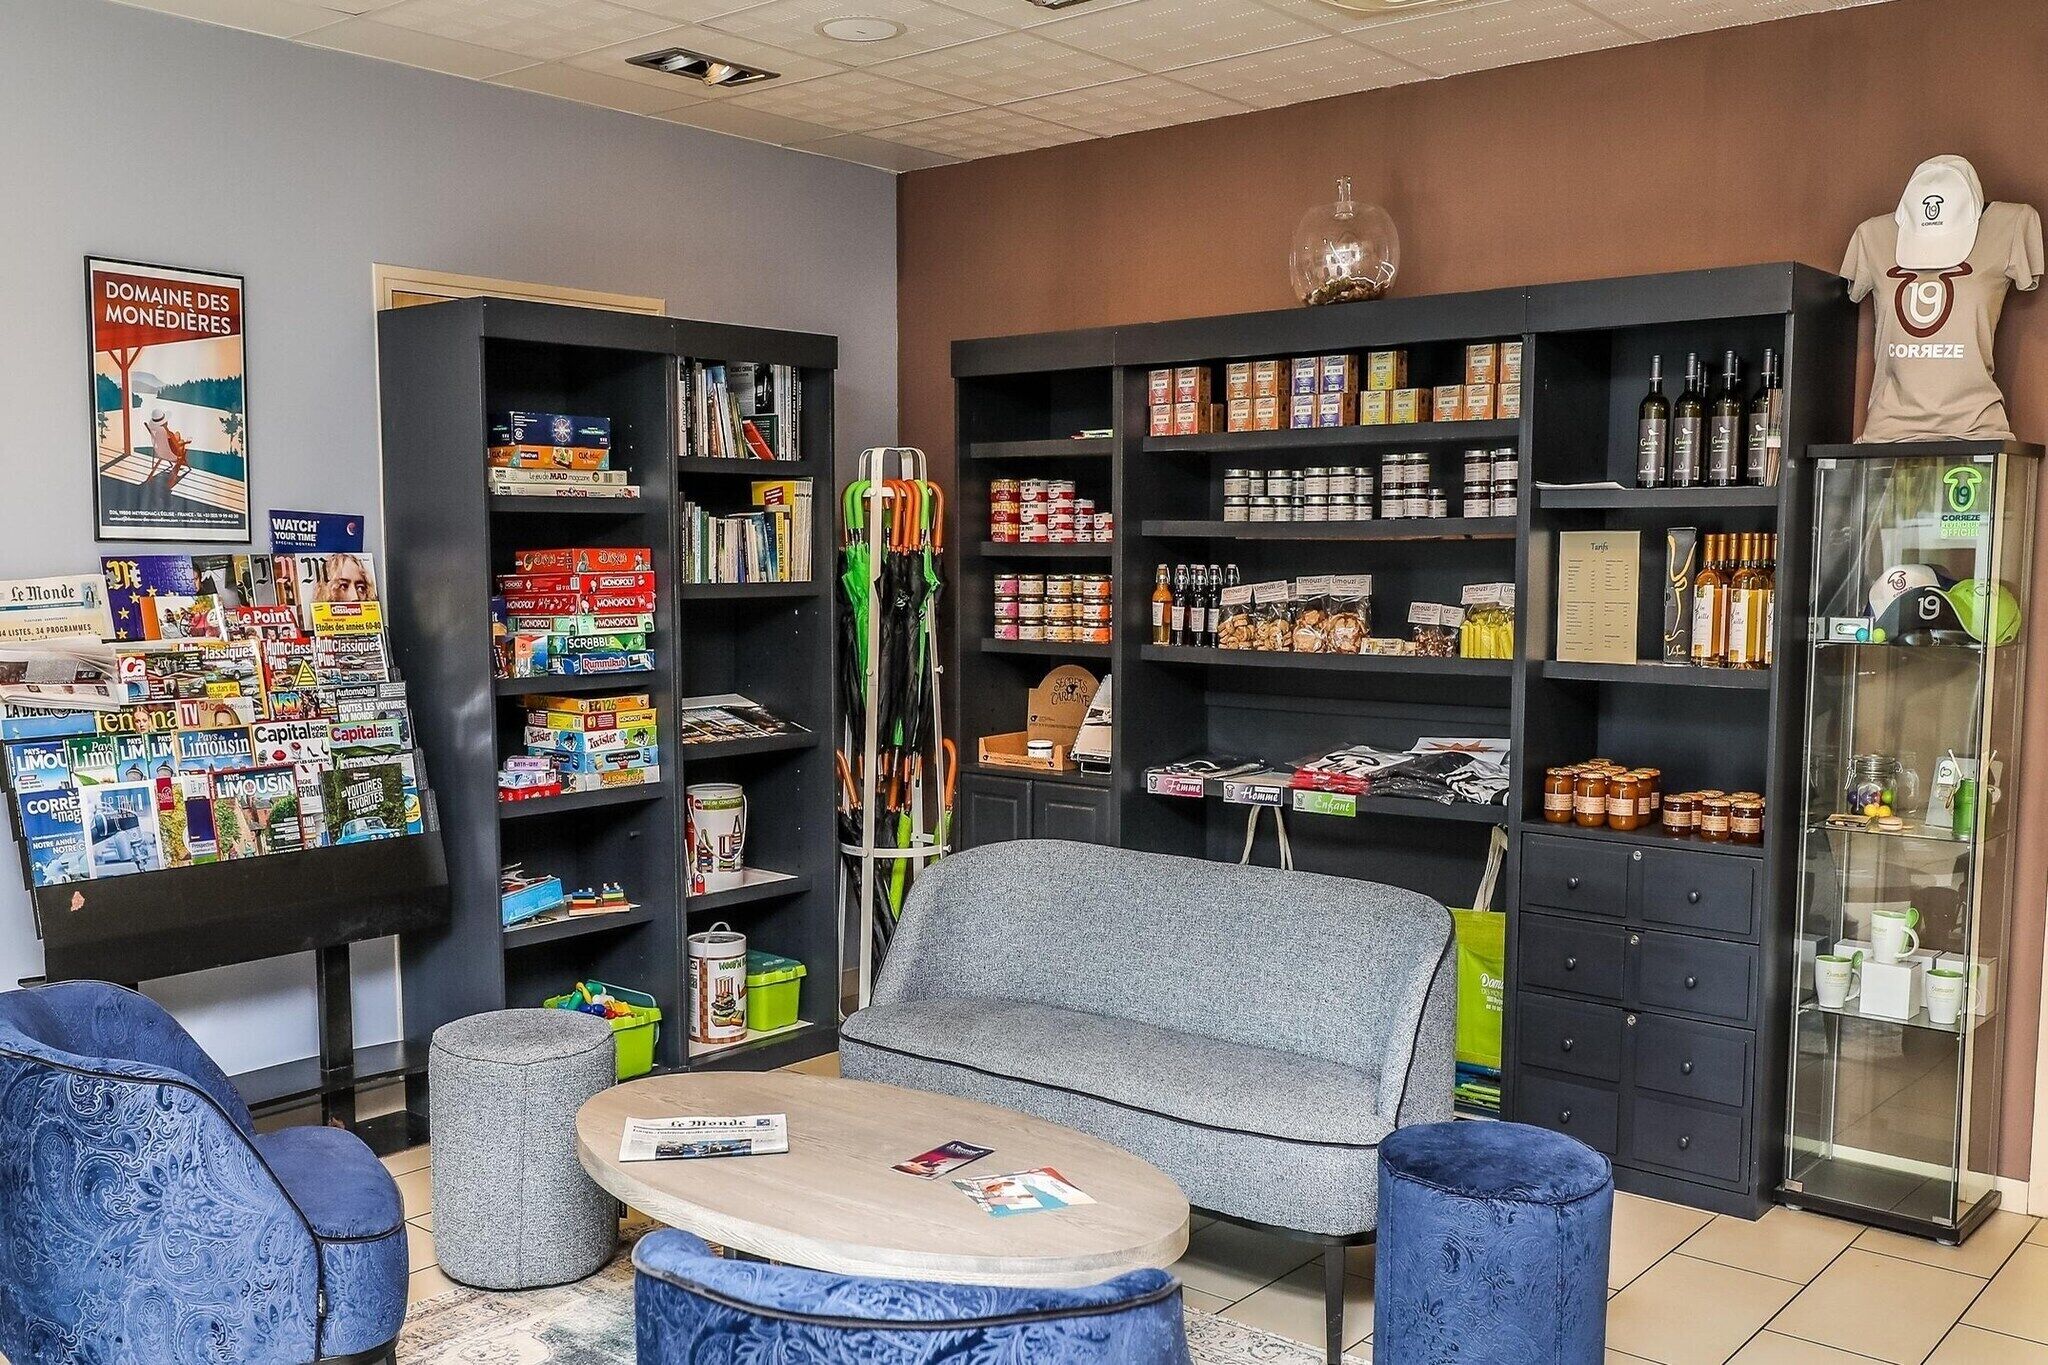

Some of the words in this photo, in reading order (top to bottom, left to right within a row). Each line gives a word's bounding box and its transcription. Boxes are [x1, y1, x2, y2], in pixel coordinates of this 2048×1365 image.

[1928, 204, 1938, 217] 19
[106, 281, 192, 309] DOMAINE
[197, 292, 230, 312] DES
[1908, 281, 1944, 324] 19
[105, 305, 231, 335] MONÉDIÈRES
[272, 518, 318, 534] WATCH
[274, 532, 296, 541] YOUR
[297, 533, 317, 542] TIME
[1590, 542, 1608, 553] Tarifs
[602, 578, 634, 587] MONOPOLY
[1331, 578, 1356, 586] Limouzi
[11, 585, 24, 602] Le
[26, 584, 75, 601] Monde
[506, 600, 536, 608] MONOPOLY
[596, 596, 636, 608] MONOPOLY
[1918, 594, 1940, 620] 19
[237, 611, 252, 624] Le
[254, 610, 292, 624] Point
[520, 619, 550, 628] MONOPOLY
[597, 618, 638, 627] MONOPOLY
[8, 628, 34, 637] LISTES,
[35, 627, 45, 635] 34
[46, 624, 92, 634] PROGRAMMES
[333, 641, 381, 655] Classiques
[568, 636, 616, 650] SCRABBLE
[268, 652, 287, 670] Plus
[318, 653, 336, 667] Plus
[582, 657, 627, 671] Rummikub
[336, 687, 376, 697] Automobile
[1054, 677, 1088, 693] SECRETS
[271, 692, 300, 715] VSD
[338, 702, 362, 714] TOUTES
[363, 702, 376, 712] LES
[376, 700, 407, 710] VOITURES
[5, 704, 20, 718] LA
[182, 704, 198, 725] TV
[350, 711, 375, 721] MONDE
[197, 732, 218, 742] Pays
[254, 722, 312, 744] Capital
[331, 724, 378, 743] Capital
[530, 730, 552, 744] Twister
[587, 730, 618, 750] Twister
[24, 748, 40, 756] PAYS
[179, 733, 252, 758] Limousin
[223, 774, 240, 782] PAYS
[346, 778, 383, 798] VOITURES
[1164, 778, 1201, 794] Femme
[1240, 784, 1279, 802] Homme
[27, 791, 80, 814] CORRÈ
[348, 792, 384, 810] FAVORITES
[1314, 794, 1351, 814] Enfant
[58, 810, 81, 824] mag
[32, 841, 54, 850] NOTRE
[56, 836, 76, 846] ANNÉE
[52, 844, 77, 854] NOTRE
[690, 1119, 746, 1127] Monde
